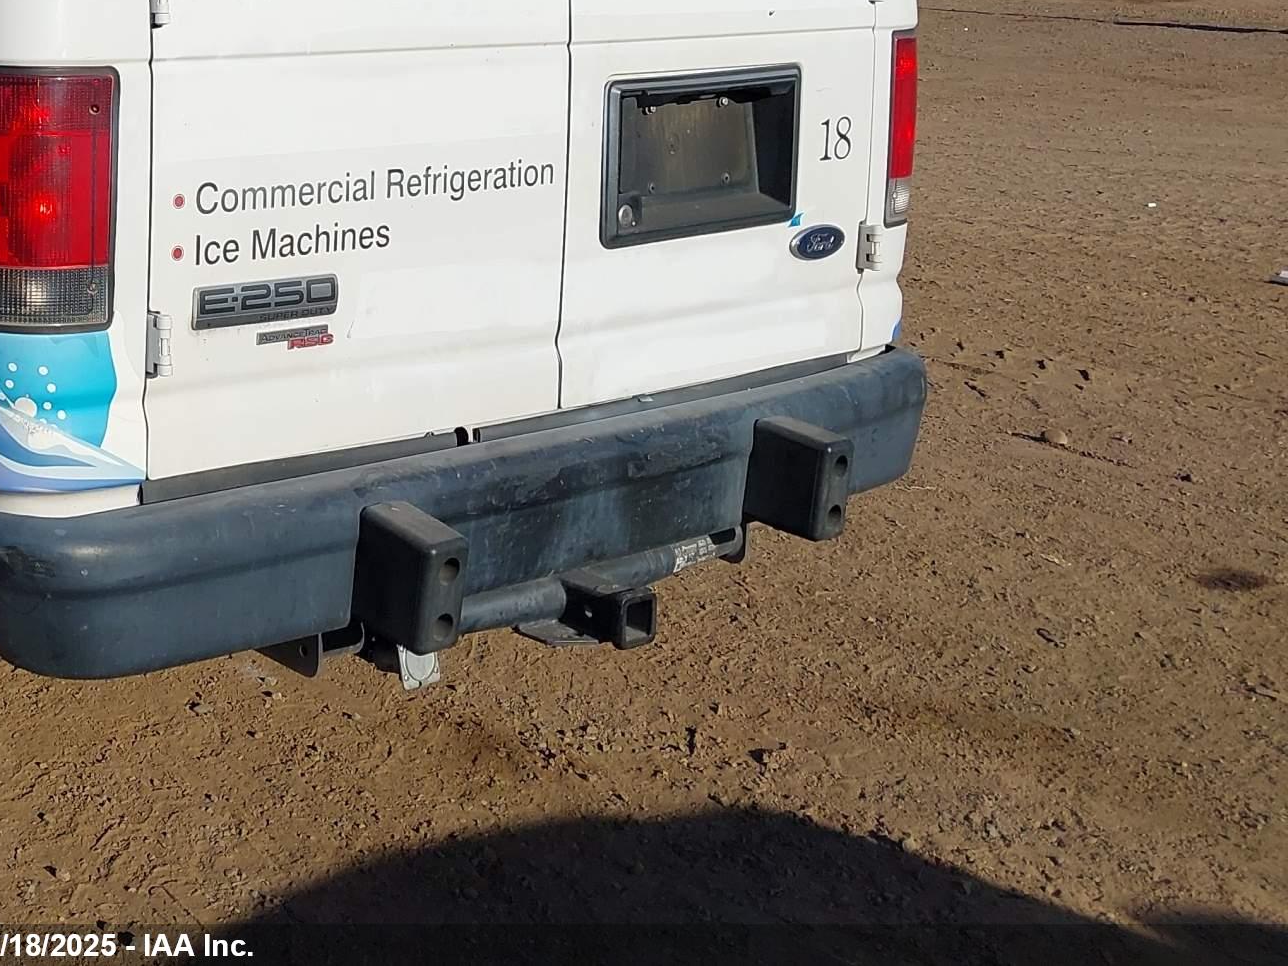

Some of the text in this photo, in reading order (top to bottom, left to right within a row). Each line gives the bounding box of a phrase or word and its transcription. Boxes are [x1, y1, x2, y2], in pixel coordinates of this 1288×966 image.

[819, 116, 852, 161] 18
[196, 159, 554, 215] Commercial Refrigeration
[195, 223, 390, 266] Ice Machines
